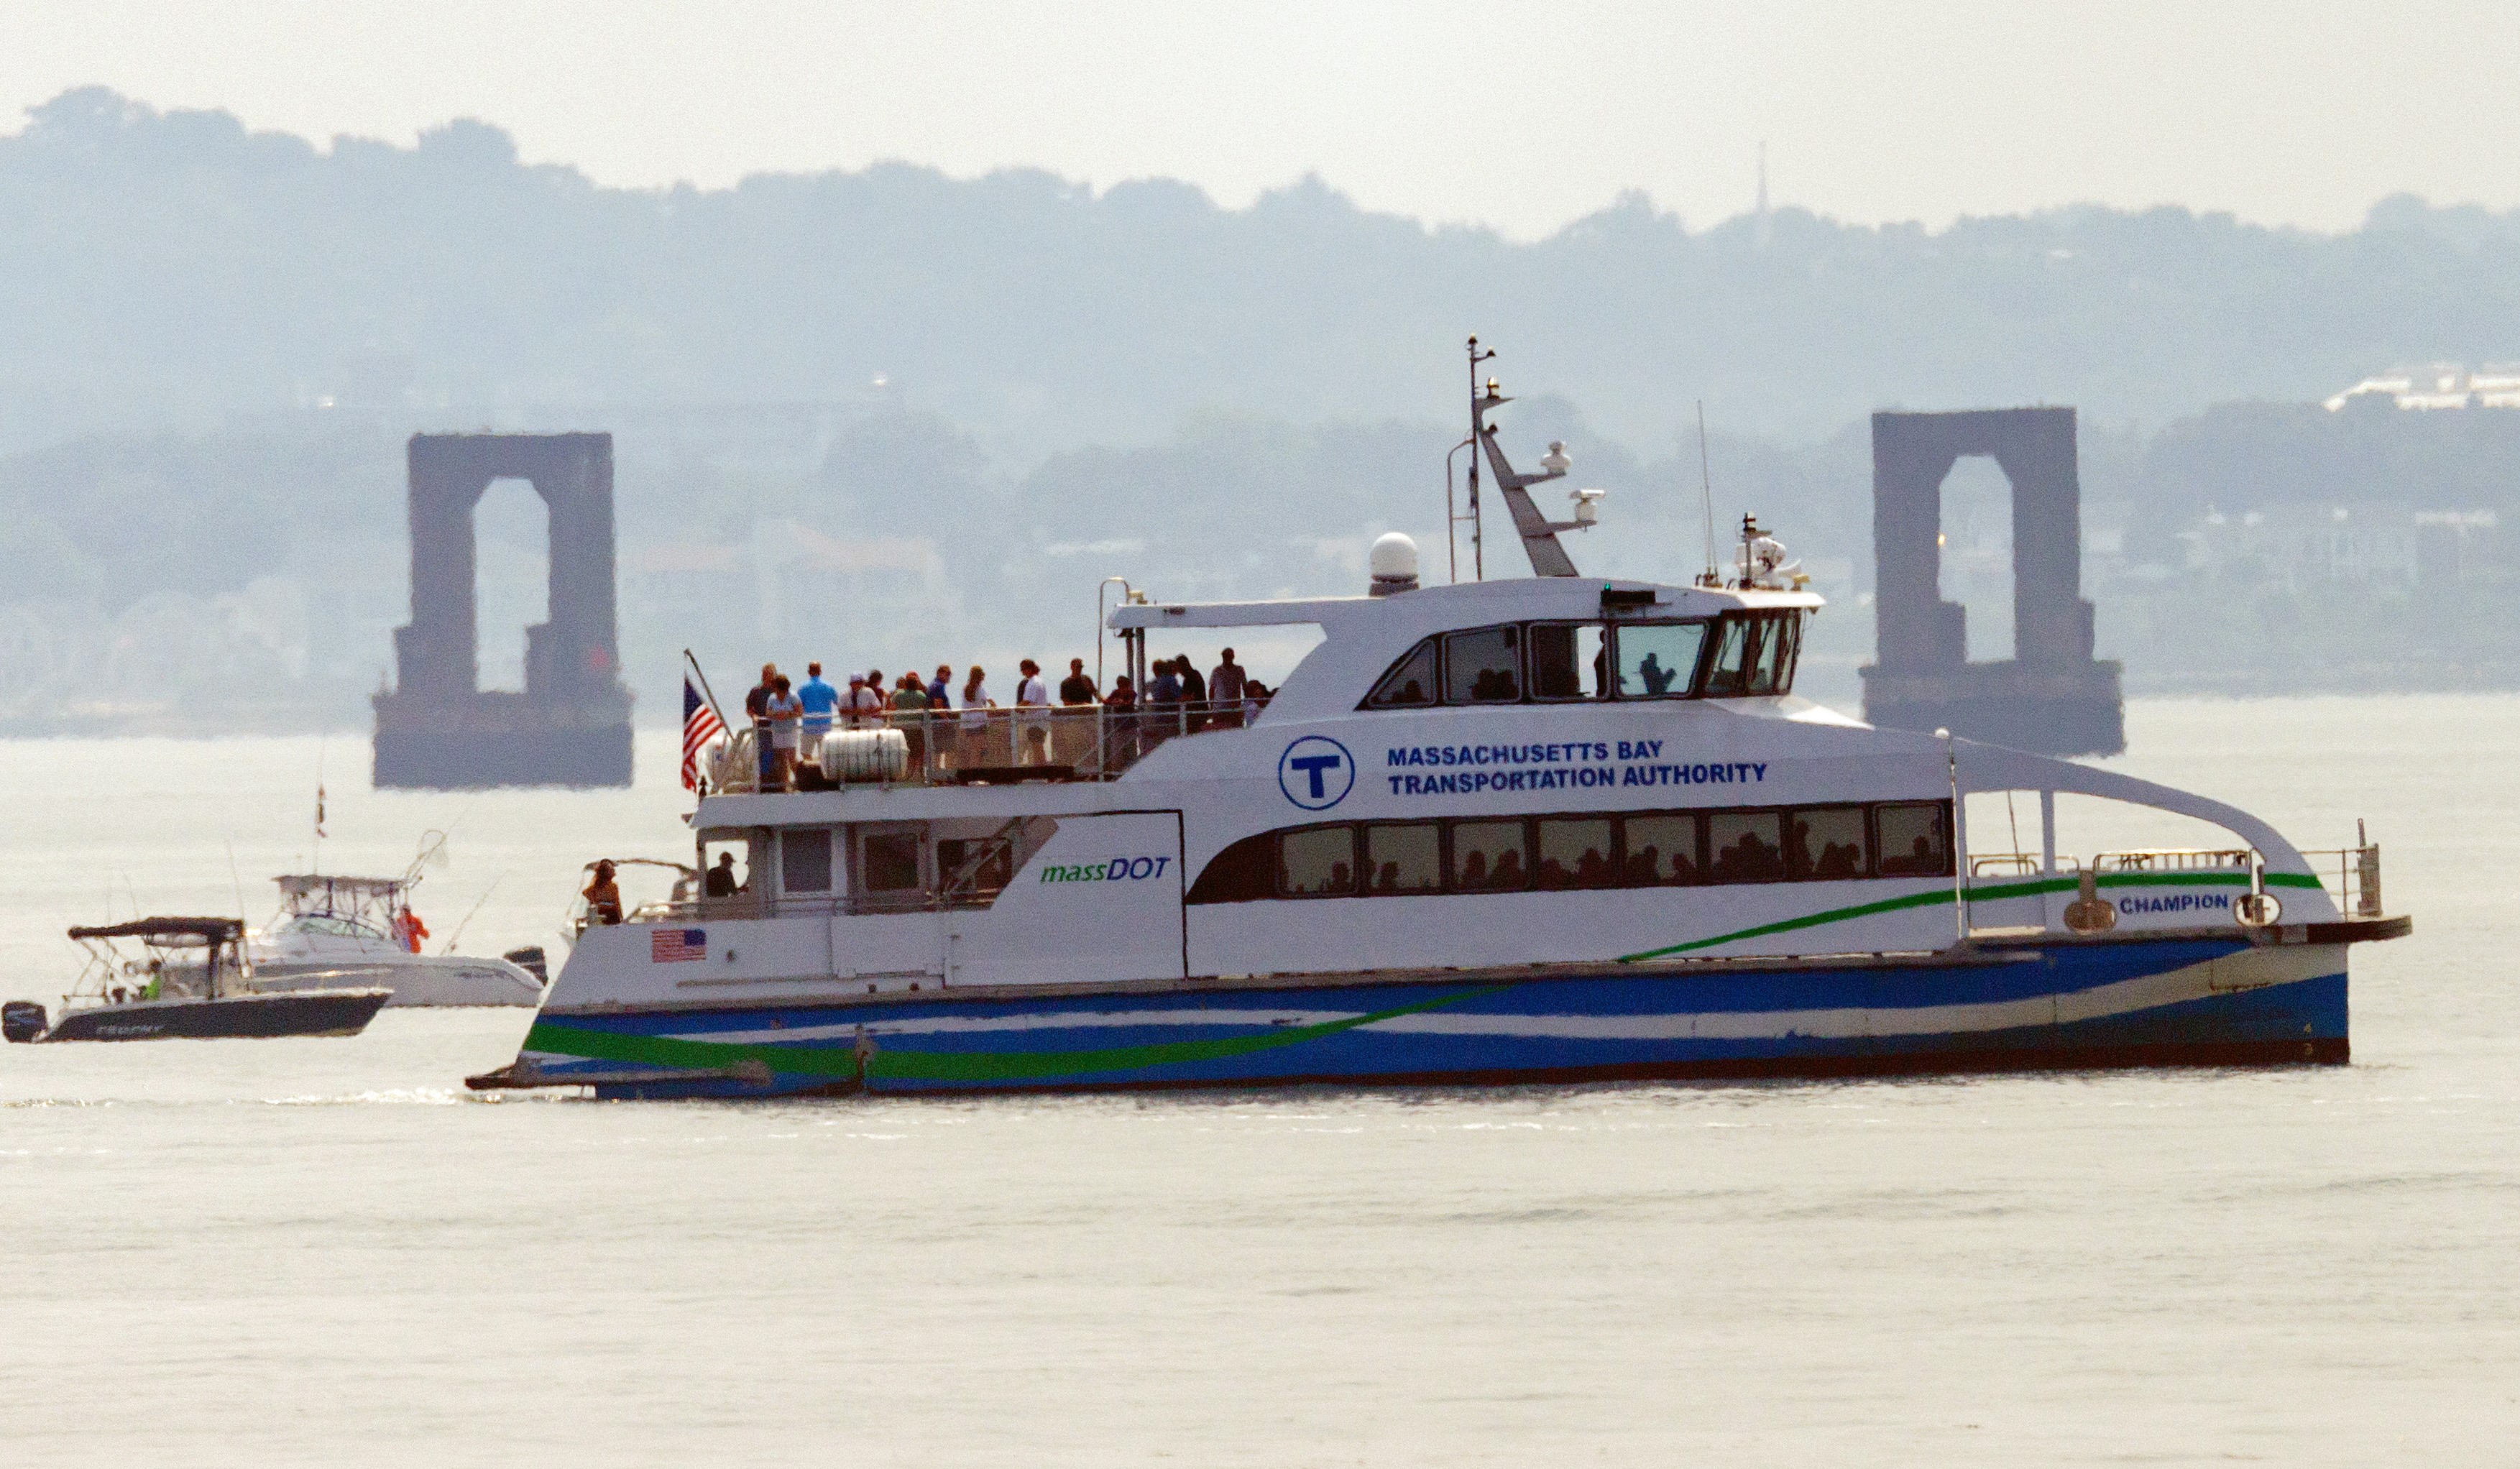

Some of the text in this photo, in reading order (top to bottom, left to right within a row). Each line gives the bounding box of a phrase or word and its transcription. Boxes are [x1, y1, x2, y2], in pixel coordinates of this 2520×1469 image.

[1387, 740, 1663, 767] MASSACHUSETTS BAY
[1291, 755, 1341, 798] T
[1388, 763, 1767, 796] TRANSPORTATION AUTHORITY
[1041, 857, 1171, 884] massDOT
[2120, 894, 2228, 915] CHAMPION
